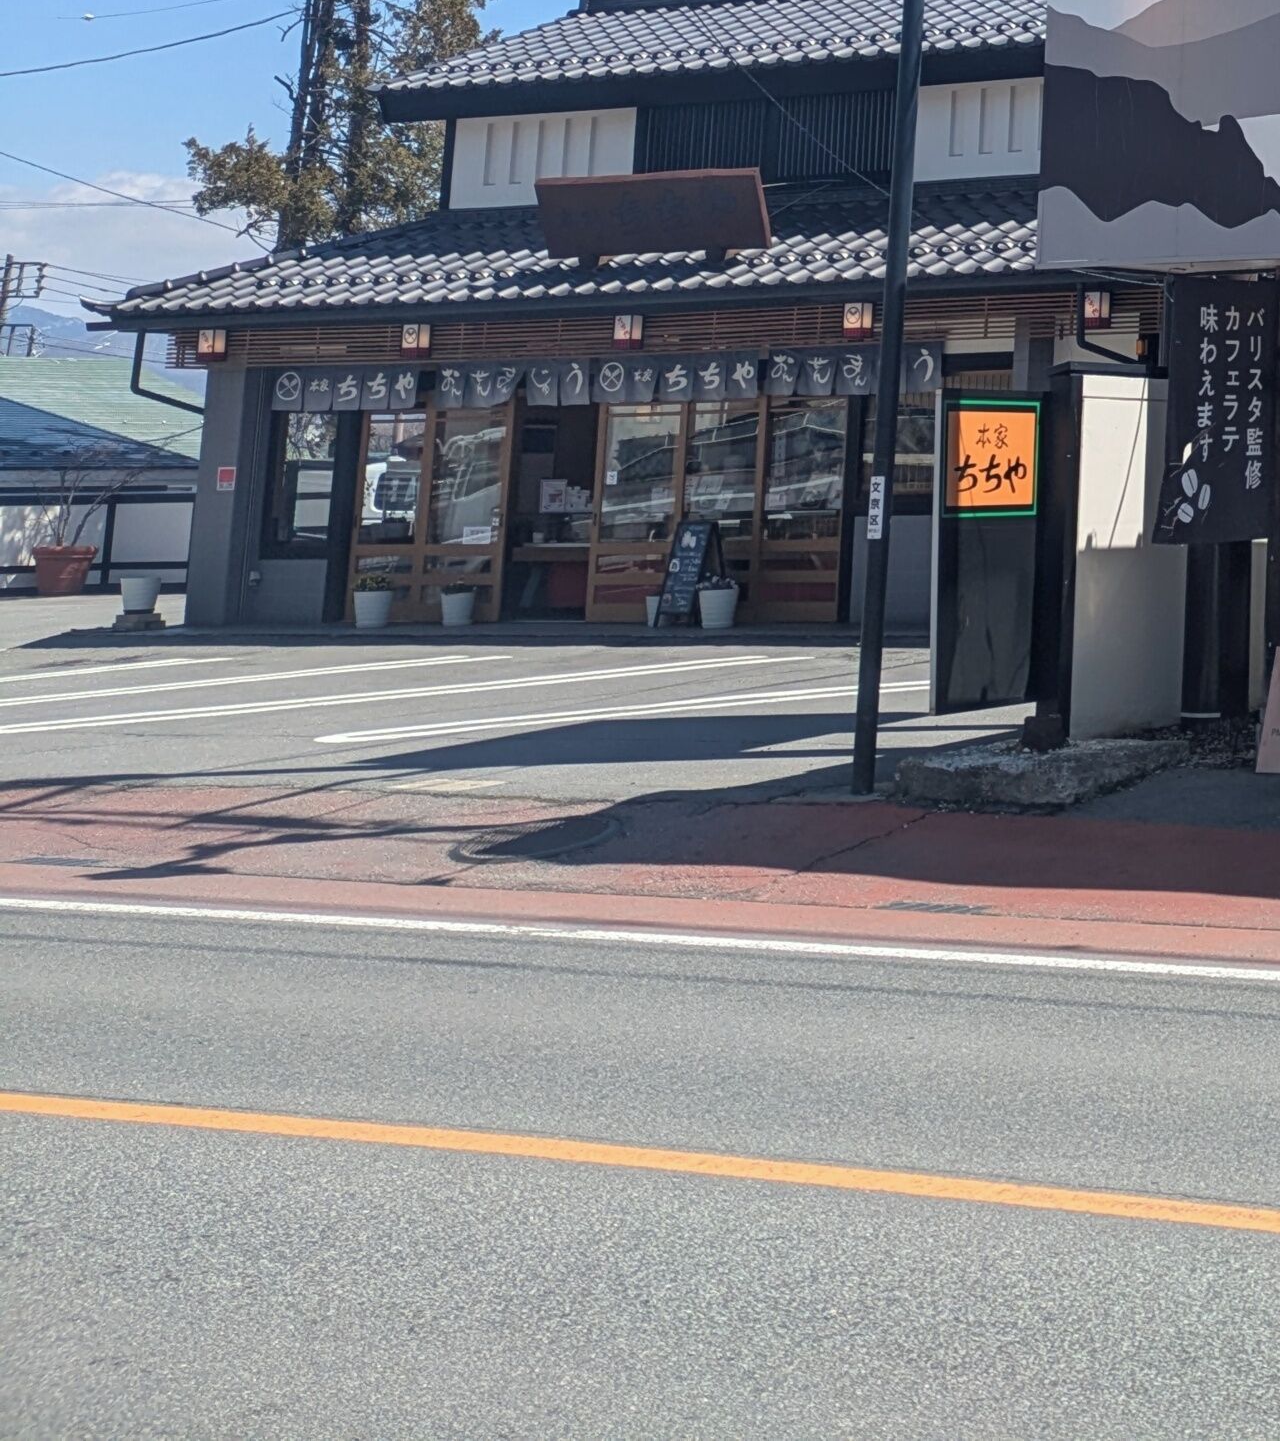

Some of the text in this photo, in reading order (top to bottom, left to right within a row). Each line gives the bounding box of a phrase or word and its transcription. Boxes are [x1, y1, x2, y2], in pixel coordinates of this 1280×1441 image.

[1196, 303, 1219, 463] 味わえます
[1221, 305, 1241, 453] カフェラテ
[1244, 307, 1266, 490] バリスタ監修
[953, 453, 1028, 494] ちちや
